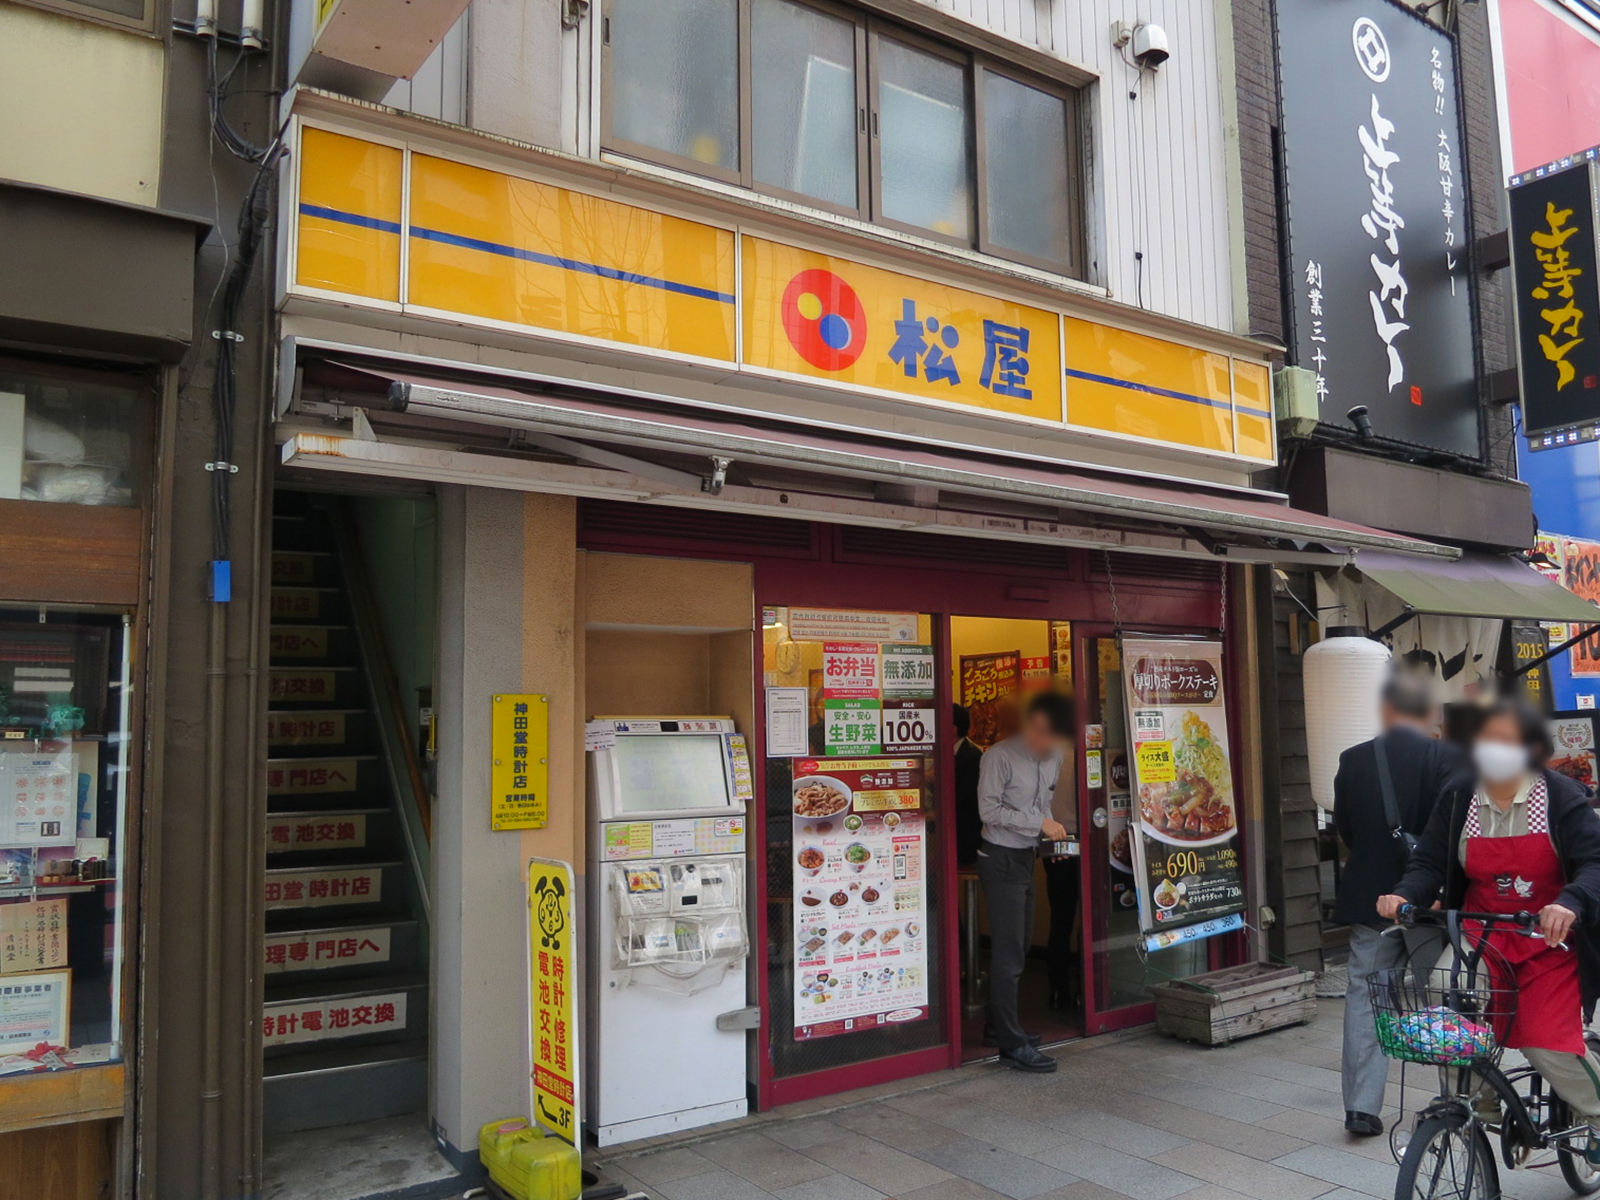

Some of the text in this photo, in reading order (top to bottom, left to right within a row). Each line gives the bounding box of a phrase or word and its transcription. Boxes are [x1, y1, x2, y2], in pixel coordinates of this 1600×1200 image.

[1436, 128, 1458, 298] 大阪甘辛カレー
[1530, 201, 1585, 392] 上等カレー
[887, 297, 1033, 400] 松屋
[1516, 642, 1544, 659] 2015
[826, 656, 876, 677] お弁当
[884, 659, 933, 680] 無添加
[1027, 659, 1044, 669] 予告
[1133, 672, 1218, 691] 厚切りポークステーキ
[1203, 690, 1214, 698] 定食
[833, 711, 872, 721] 安全・安心
[899, 710, 920, 720] 国産米
[1138, 717, 1161, 728] 無添加
[829, 723, 877, 743] 生野菜
[885, 721, 933, 743] 100%
[512, 702, 529, 789] 神田堂時計店
[1141, 751, 1169, 762] ライス大盛
[266, 822, 356, 843] 電池交換
[265, 876, 372, 902] 田堂時計店
[265, 938, 381, 964] 理専門店へ
[538, 951, 551, 1063] 電池交換
[552, 956, 567, 1072] 時計・修理
[559, 1107, 571, 1129] 3F
